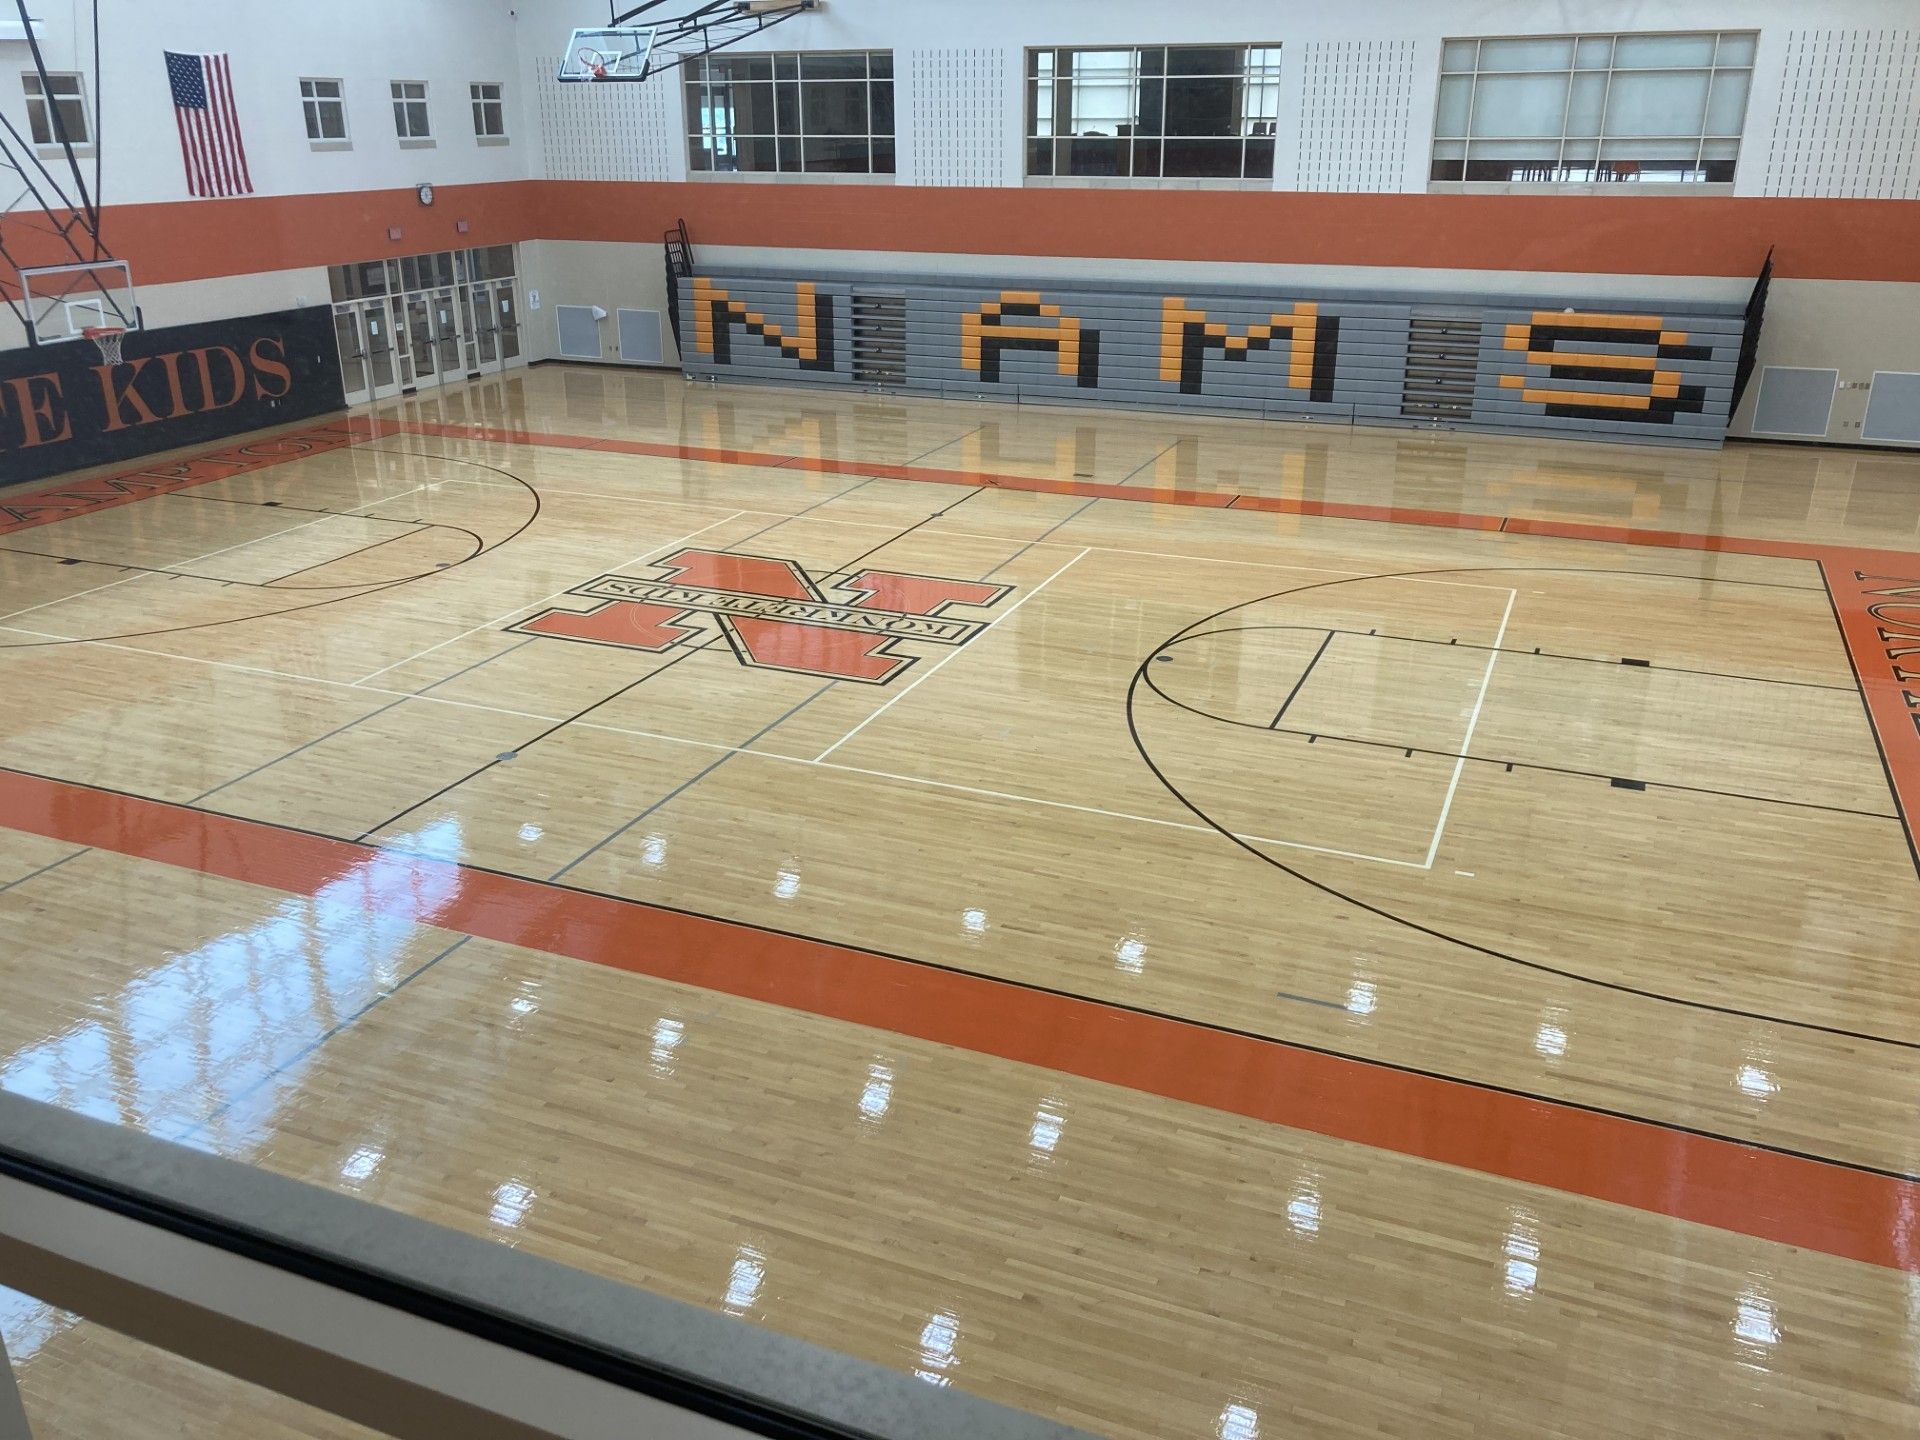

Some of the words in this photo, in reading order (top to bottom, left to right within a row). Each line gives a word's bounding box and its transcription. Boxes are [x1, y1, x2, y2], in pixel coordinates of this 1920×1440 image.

[0, 372, 73, 454] E
[89, 336, 292, 432] KIDS
[603, 583, 704, 602] KIDS
[710, 597, 951, 635] KONKRETE
